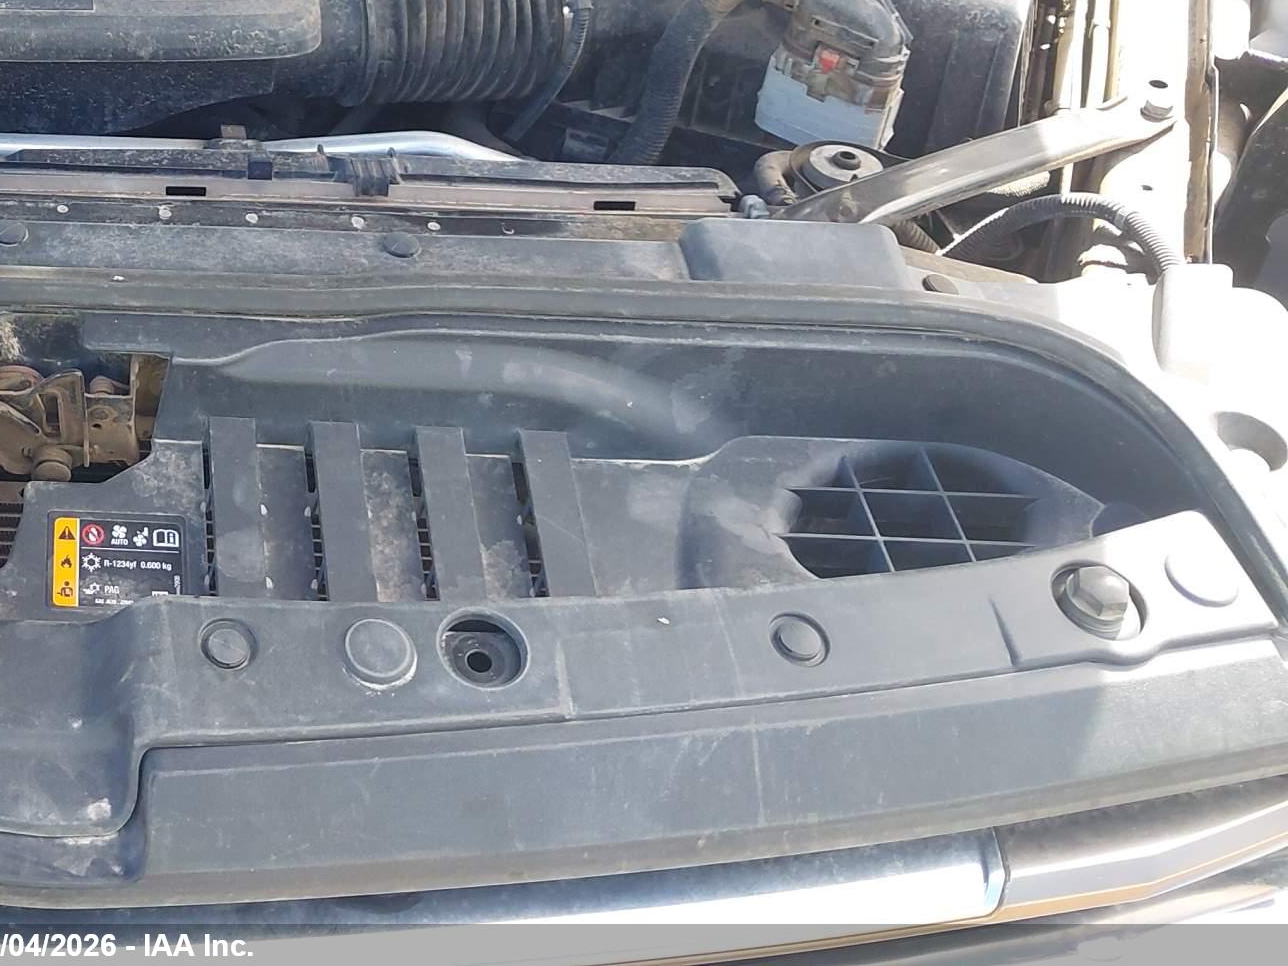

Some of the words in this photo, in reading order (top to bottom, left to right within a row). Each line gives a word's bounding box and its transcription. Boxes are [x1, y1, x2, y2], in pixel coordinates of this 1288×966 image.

[110, 538, 129, 546] AUTO
[103, 559, 137, 570] R-1234yf
[140, 560, 161, 570] 0.600
[162, 561, 172, 572] kg
[103, 585, 120, 594] PAG
